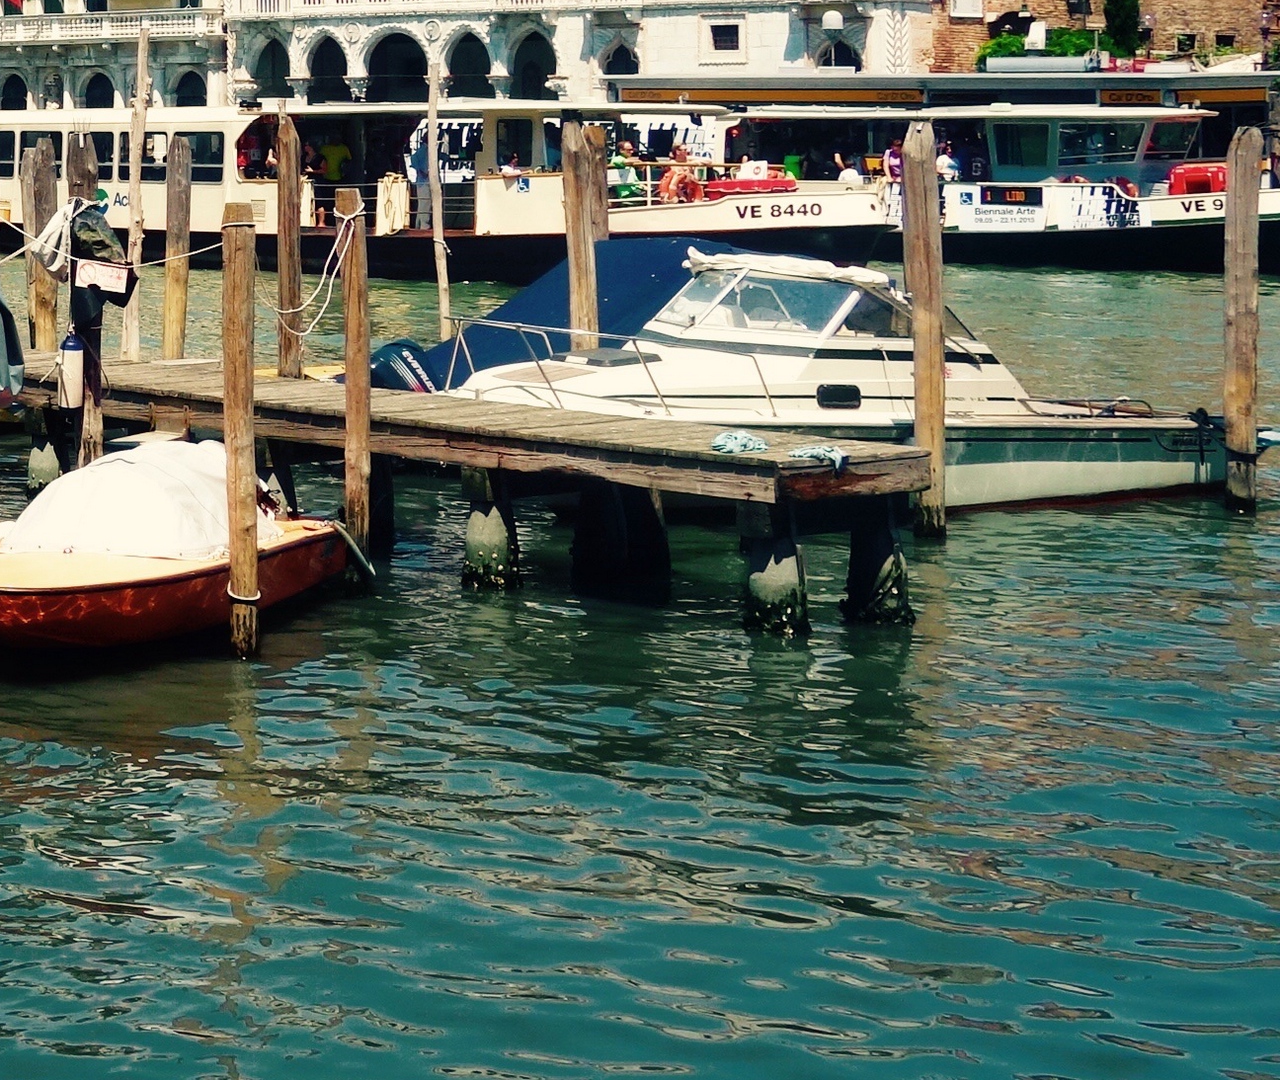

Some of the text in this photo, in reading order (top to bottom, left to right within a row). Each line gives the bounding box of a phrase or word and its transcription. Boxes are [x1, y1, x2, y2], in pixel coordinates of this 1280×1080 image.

[736, 203, 823, 219] VE 8440
[974, 207, 1036, 216] Biennale Arte
[1181, 200, 1207, 213] VE
